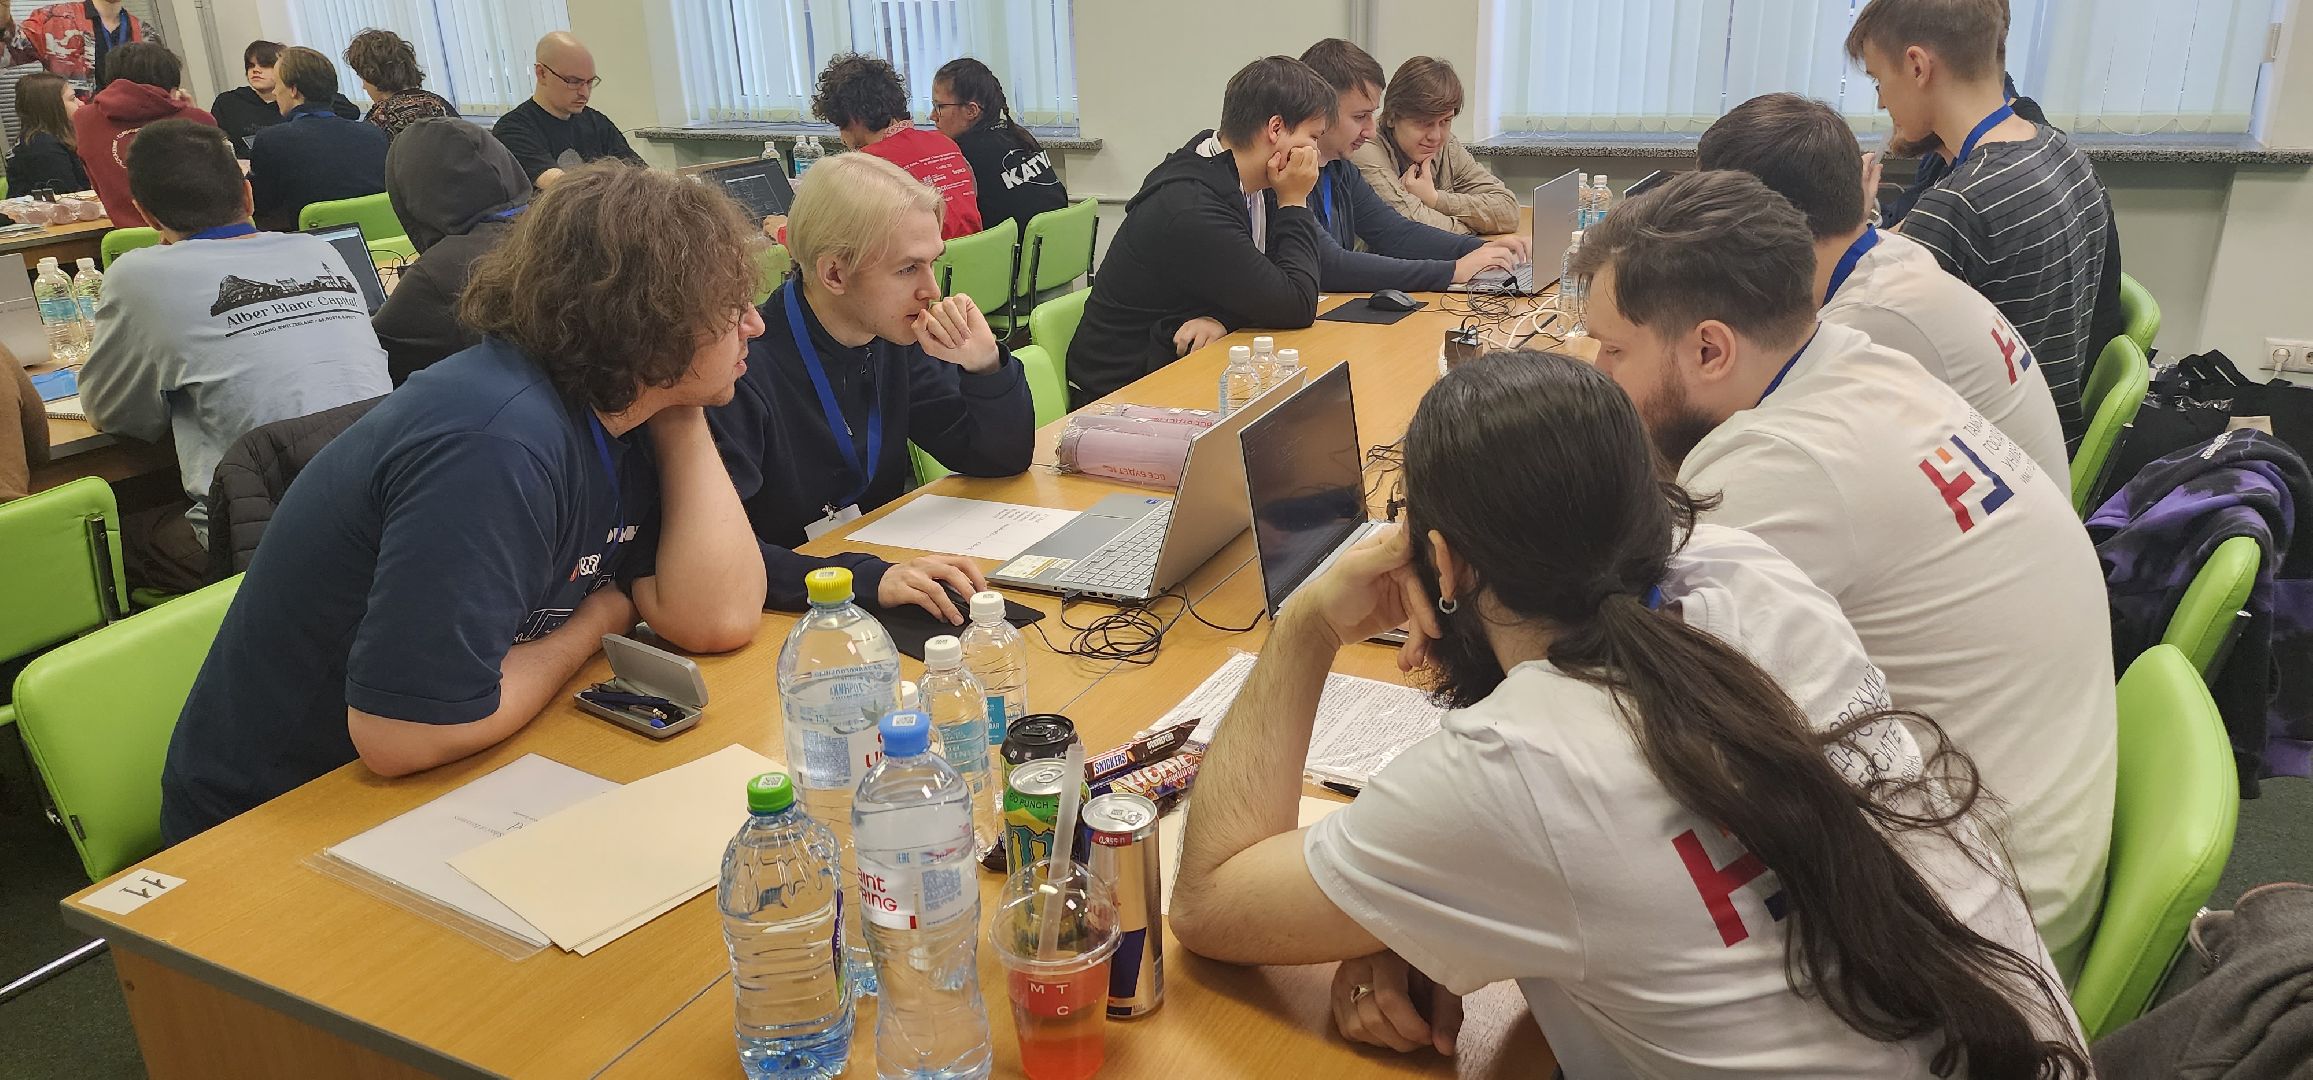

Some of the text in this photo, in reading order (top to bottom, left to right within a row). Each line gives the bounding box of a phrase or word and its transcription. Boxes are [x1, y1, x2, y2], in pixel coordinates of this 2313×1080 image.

[226, 295, 358, 328] Alber Blanc Capital
[1093, 752, 1127, 775] SNICKERS
[1020, 797, 1049, 809] PUNCH
